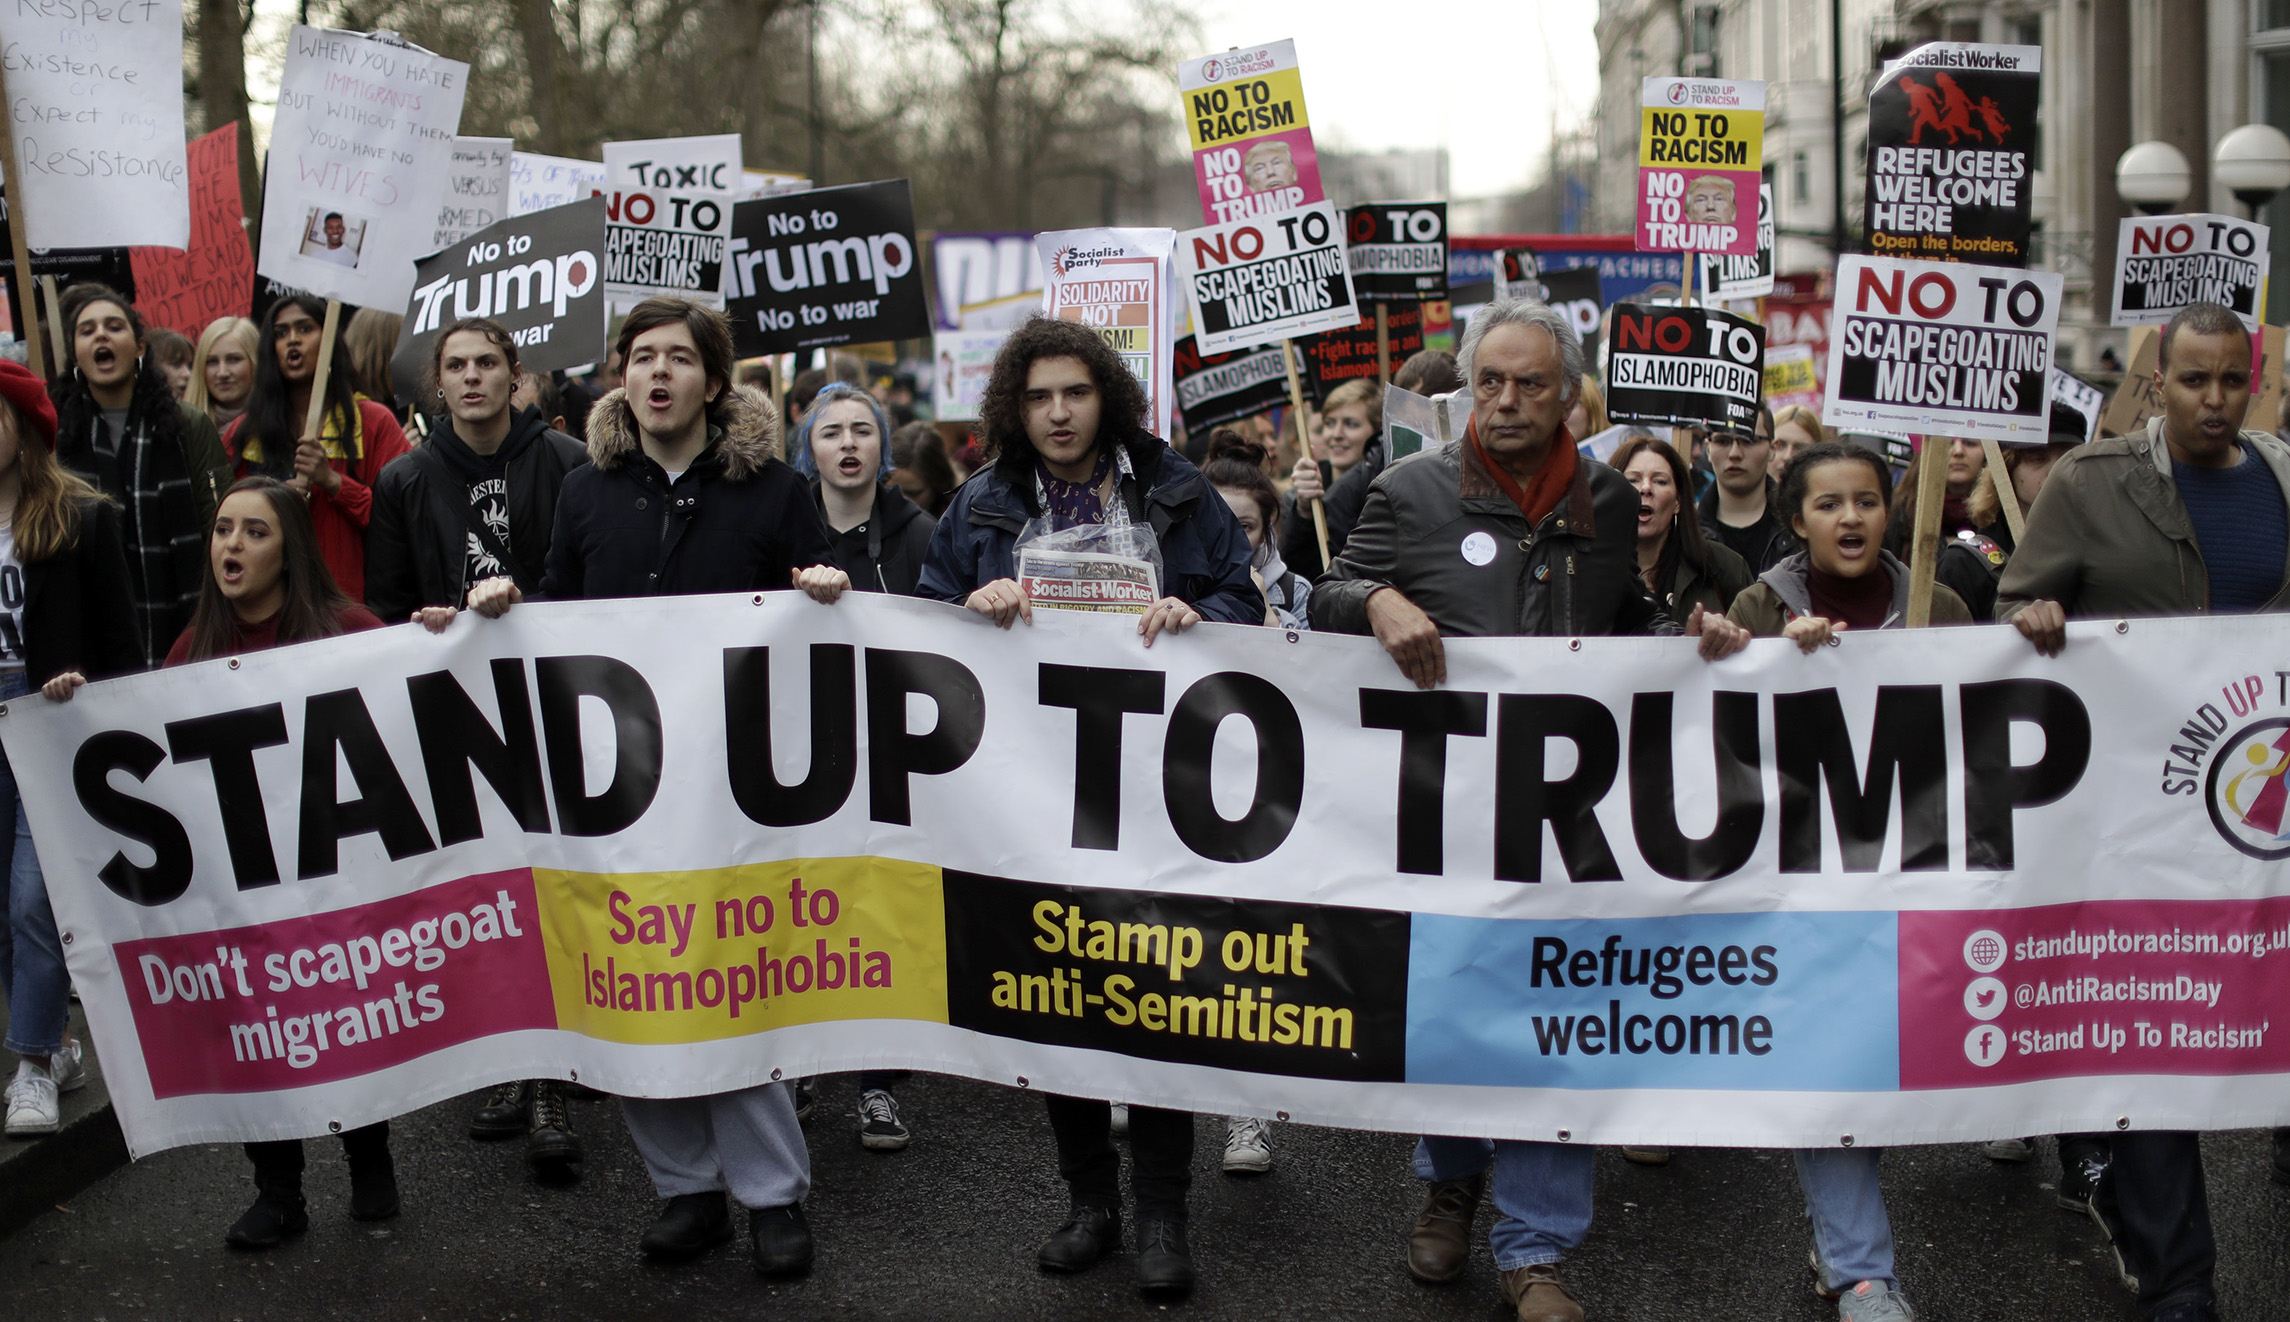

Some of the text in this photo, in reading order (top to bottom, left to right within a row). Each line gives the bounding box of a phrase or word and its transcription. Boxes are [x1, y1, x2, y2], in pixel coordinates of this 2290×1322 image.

[59, 27, 98, 52] my
[3, 42, 138, 84] Existence
[300, 34, 357, 66] WHEN
[360, 49, 396, 77] YOU
[406, 64, 454, 90] HATE
[1224, 50, 1268, 67] STAND UP
[1226, 59, 1275, 77] TO RACISM
[1965, 51, 2021, 70] Worker
[70, 82, 104, 97] or
[324, 71, 422, 110] IMMIGRANTS
[1193, 80, 1270, 118] NO TO
[1691, 84, 1736, 95] STAND UP
[1691, 95, 1740, 106] TO RACISM
[13, 98, 156, 140] Expect my
[282, 89, 454, 143] BUT WITHOUT THEM
[1198, 101, 1295, 143] RACISM
[1652, 112, 1729, 138] NO TO
[23, 137, 183, 188] Resistance
[352, 142, 387, 159] HAVE
[391, 151, 414, 165] NO
[1202, 148, 1242, 178] NO
[1650, 138, 1748, 165] RACISM
[1876, 146, 2026, 179] REFUGEES
[297, 154, 399, 206] WIVES
[629, 161, 728, 190] TOXIC
[1206, 174, 1244, 202] TO
[1647, 171, 1685, 198] NO
[1874, 175, 2017, 207] WELCOME
[593, 190, 721, 231] NO TO
[767, 209, 839, 237] No to
[1211, 186, 1305, 226] TRUMP
[1646, 197, 1682, 223] TO
[1873, 203, 1953, 232] HERE
[1192, 211, 1330, 270] NO TO
[1387, 209, 1441, 243] TO
[1645, 222, 1739, 251] TRUMP
[1871, 231, 2019, 255] Open the borders,
[2132, 221, 2256, 258] NO TO
[467, 235, 532, 267] No to
[604, 226, 724, 264] APEGOATING
[1068, 247, 1125, 260] Socialist
[190, 263, 253, 317] TODAY
[604, 253, 703, 290] MUSLIMS
[1194, 247, 1343, 303] SCAPEGOATING
[2125, 256, 2258, 288] SCAPEGOATING
[413, 250, 598, 336] Trump
[1061, 280, 1149, 306] SOLIDARITY
[1224, 279, 1333, 328] MUSLIMS
[1856, 266, 2045, 328] NO TO
[2144, 277, 2236, 309] MUSLIMS
[757, 299, 880, 333] No to war
[1080, 304, 1122, 327] NOT
[1318, 341, 1352, 361] Fight
[1619, 313, 1692, 353] NO
[1706, 319, 1759, 365] TO
[1844, 319, 2048, 373] SCAPEGOATING
[1180, 345, 1304, 403] ISLAMOPHOBA
[1614, 357, 1756, 400] ISLAMOPHOBIA
[1875, 360, 2020, 412] MUSLIMS
[1727, 403, 1745, 419] FOA
[1031, 578, 1153, 602] Socialist Worker
[2161, 671, 2290, 796] STAND UP T
[72, 643, 2092, 907] STAND UP TO TRUMP
[609, 877, 841, 957] Say no to
[141, 889, 523, 1005] Don't scapegoat
[1032, 900, 1310, 982] Stamp out
[583, 936, 893, 1019] Islamophobia
[1530, 935, 1779, 998] Refugees
[992, 966, 1355, 1050] anti-Semitism
[2014, 975, 2223, 1010] @AntiRacismDay
[229, 980, 445, 1069] migrants
[1532, 1000, 1774, 1057] welcome
[2091, 1022, 2126, 1052] Up
[2134, 1022, 2162, 1048] To
